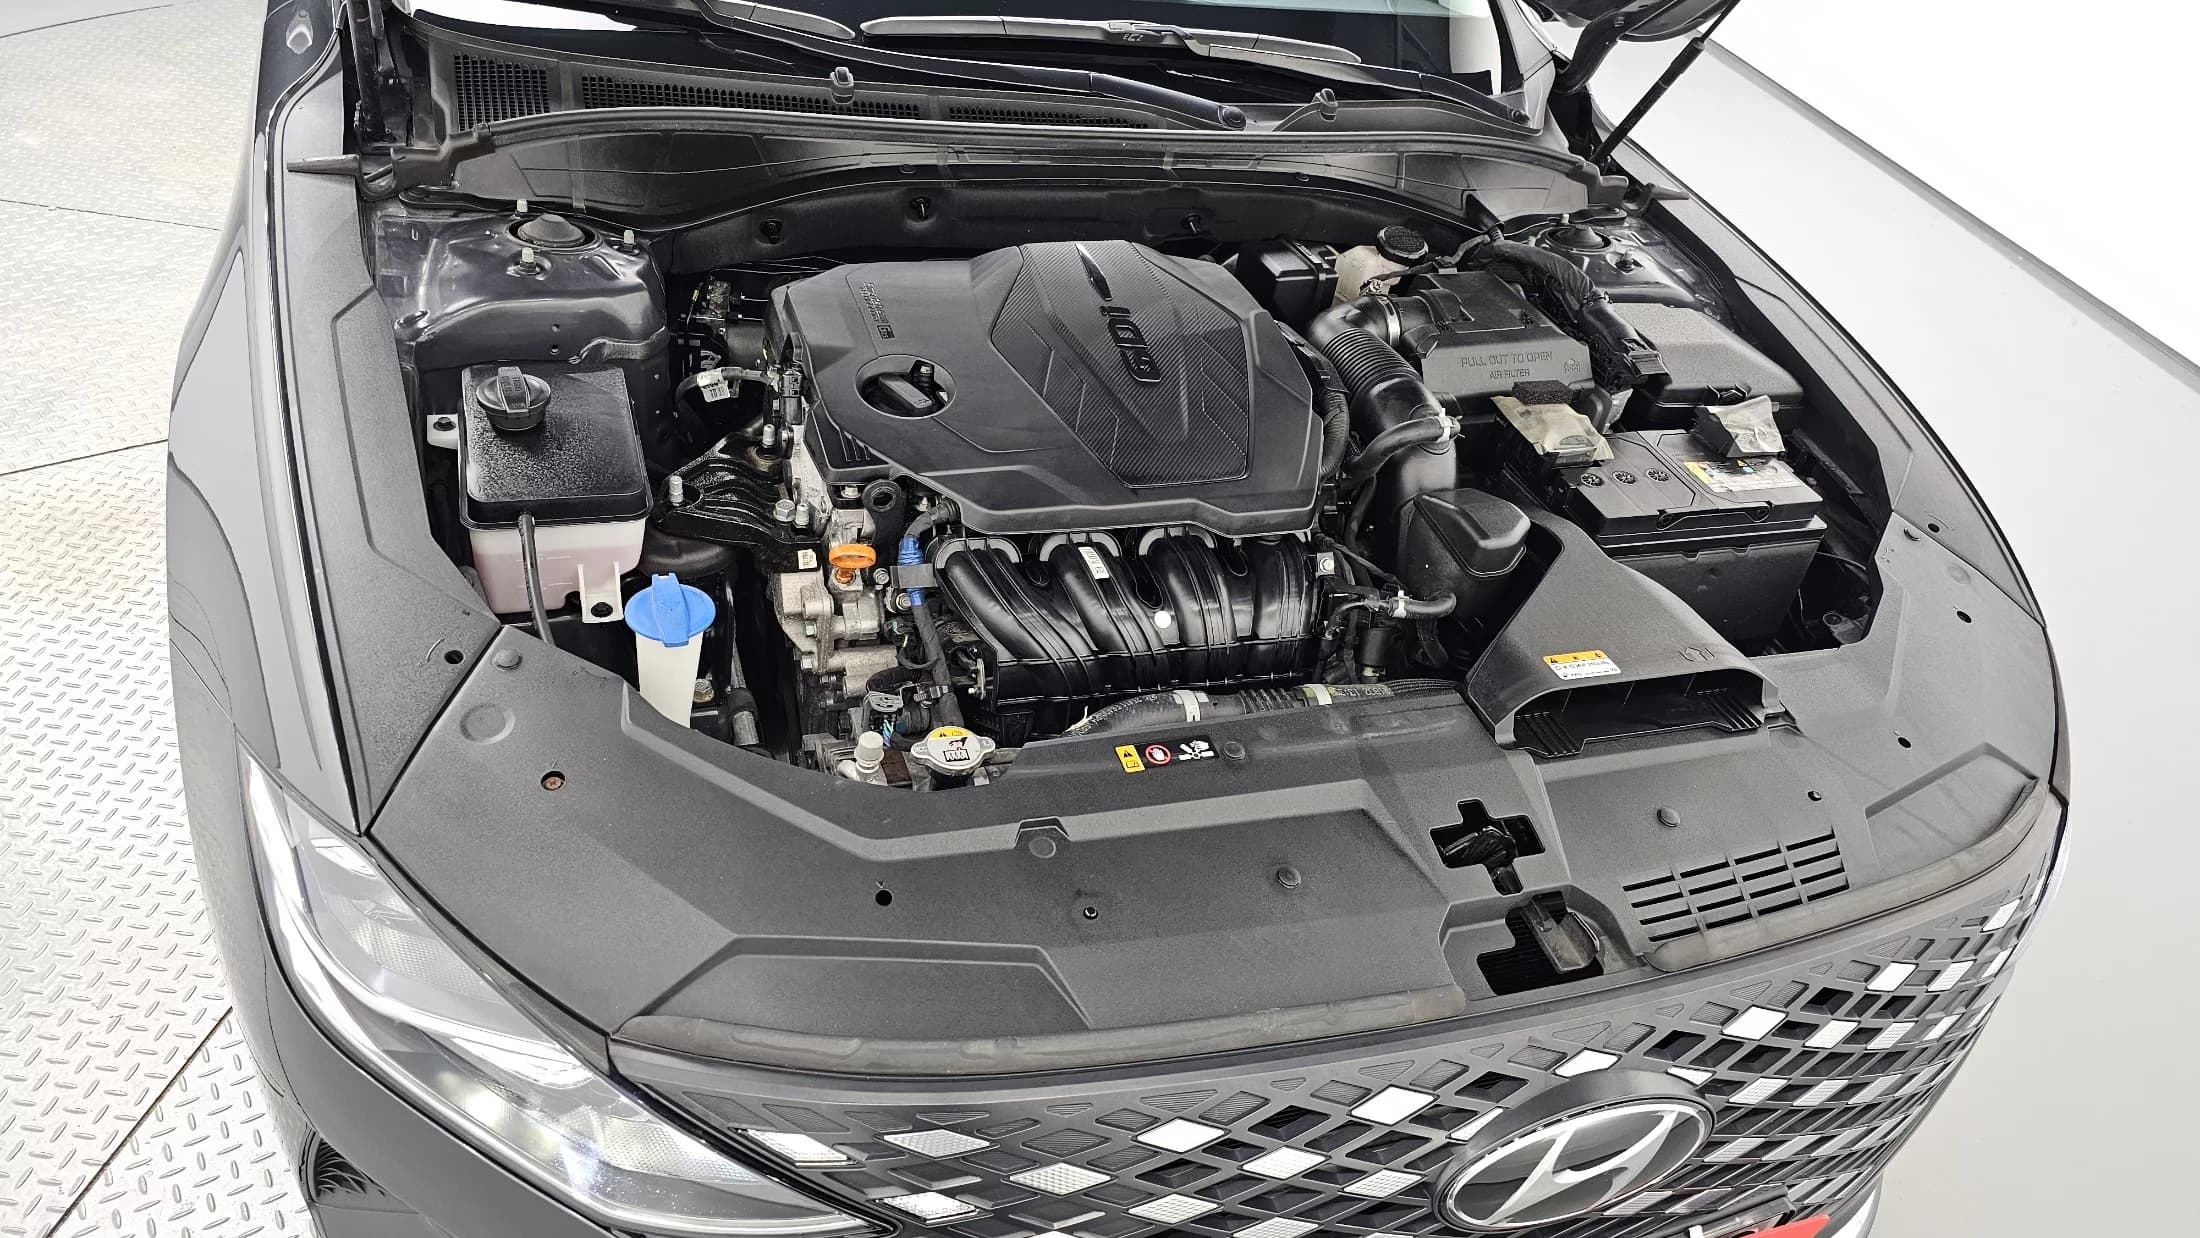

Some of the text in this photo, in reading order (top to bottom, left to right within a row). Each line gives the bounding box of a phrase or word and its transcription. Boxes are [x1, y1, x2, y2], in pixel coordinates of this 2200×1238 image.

[1460, 350, 1553, 368] PULL OUT TO OPEN
[1489, 368, 1531, 380] AIR FILTER
